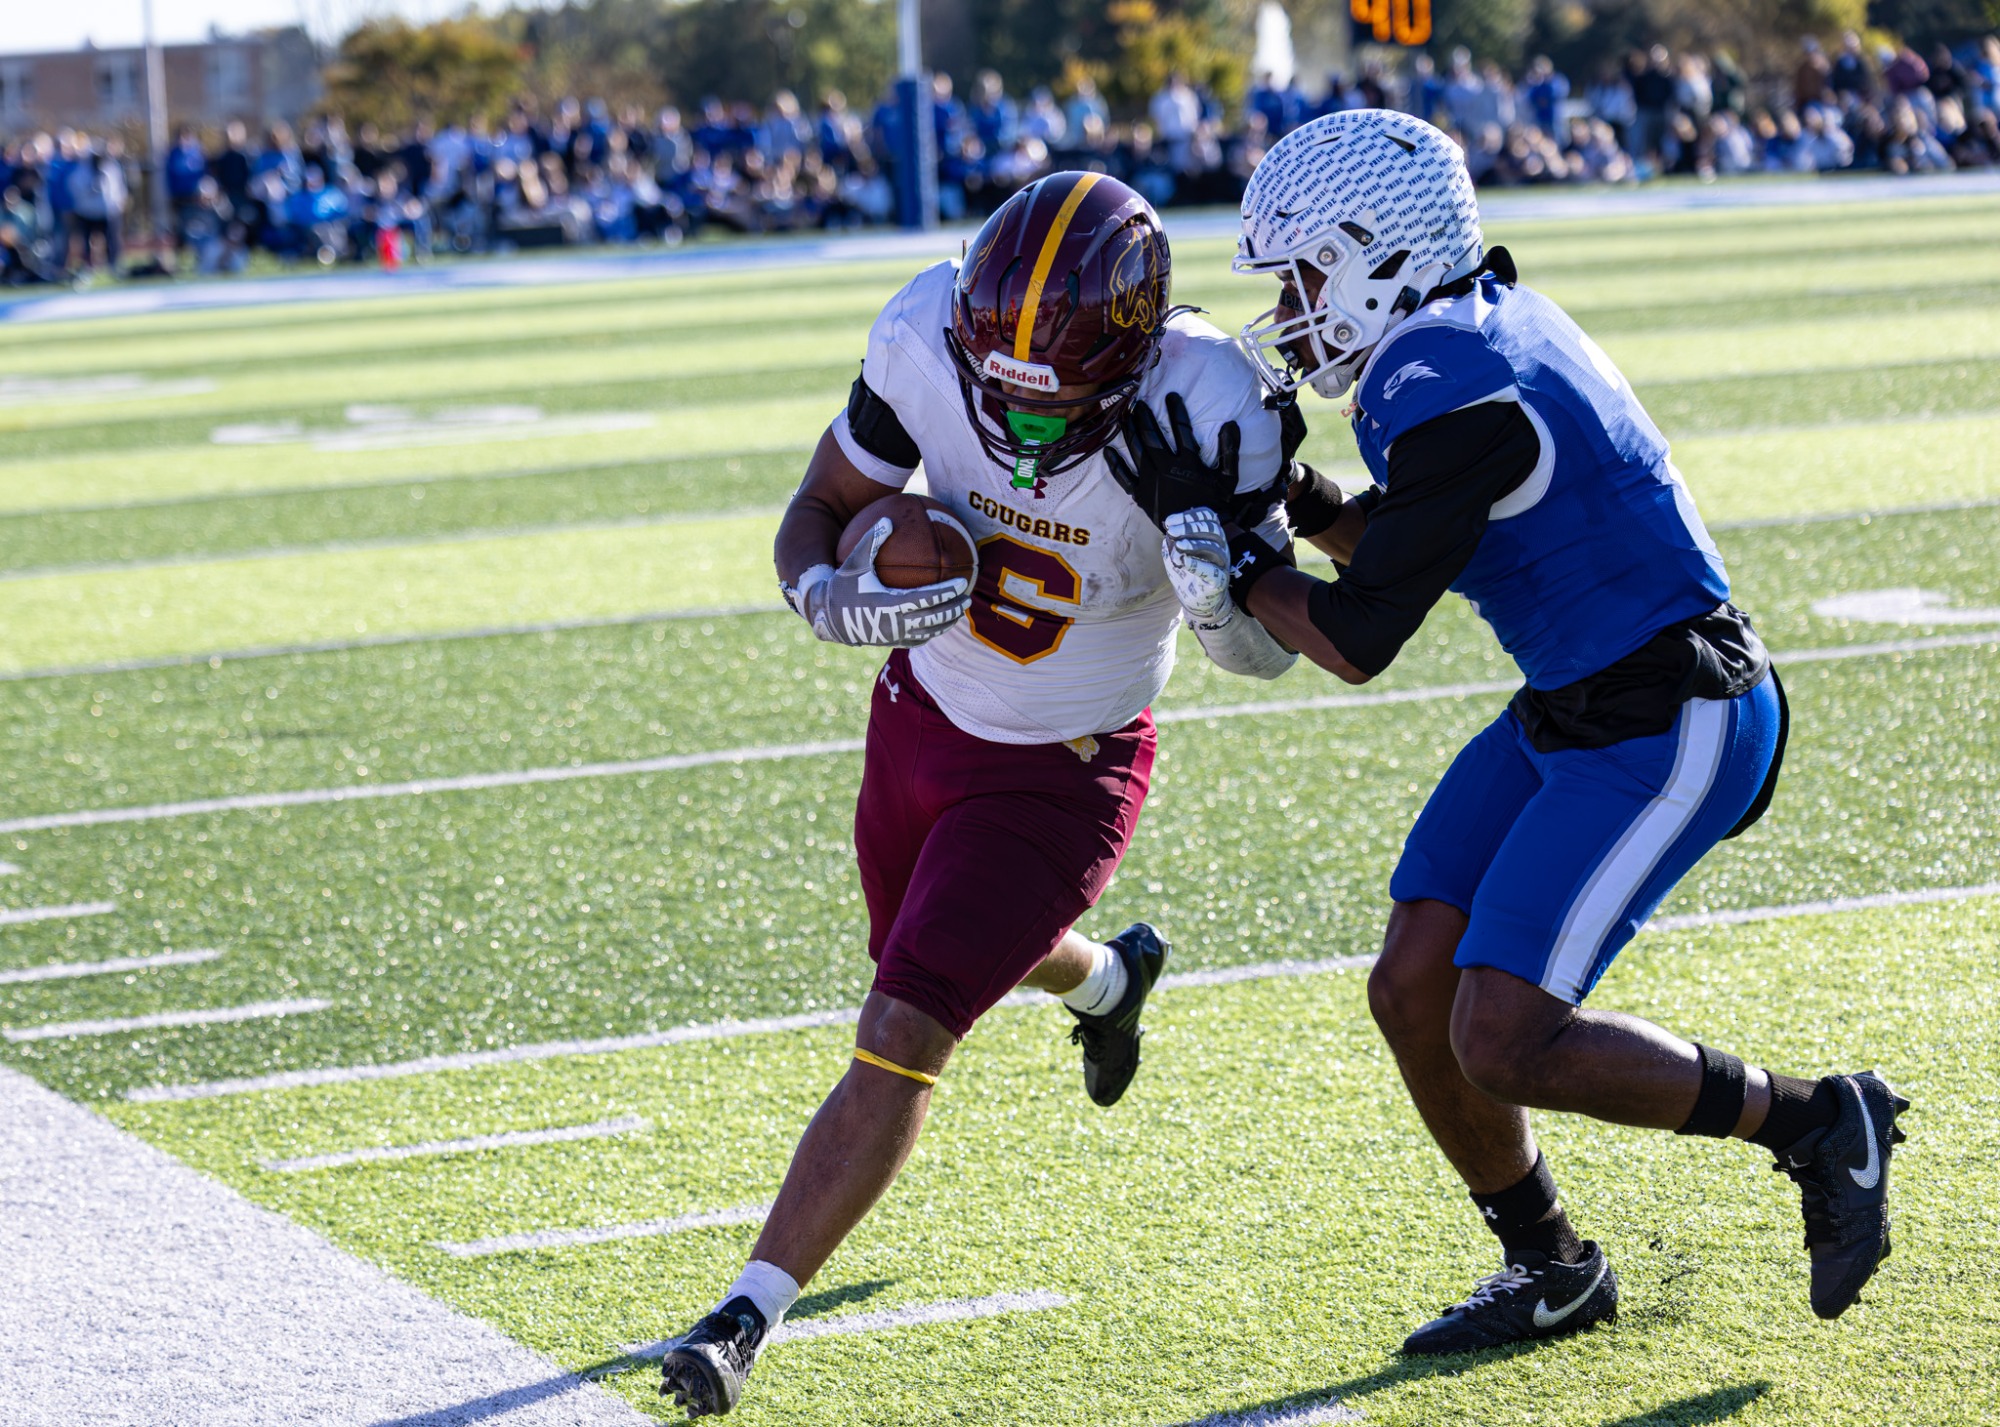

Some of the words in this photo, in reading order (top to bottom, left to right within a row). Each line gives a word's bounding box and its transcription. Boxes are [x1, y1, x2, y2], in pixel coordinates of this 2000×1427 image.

[1324, 126, 1345, 135] PRIDE
[1351, 121, 1368, 134] PRIDE
[1296, 134, 1315, 148] PRIDE
[1348, 135, 1366, 148] PRIDE
[1380, 140, 1393, 151] PRID
[1273, 149, 1291, 164] PRIDE
[1295, 145, 1313, 161] PRIDE
[1326, 142, 1344, 157] PRIDE
[1338, 149, 1357, 164] PRIDE
[1359, 142, 1377, 156] PRIDE
[1390, 149, 1407, 162] PRIDE
[1307, 149, 1325, 166] PRIDE
[1369, 153, 1387, 168] PRIDE
[1420, 157, 1436, 169] PRIDE
[1276, 159, 1291, 177] PRIDE
[1288, 160, 1304, 177] PRIDE
[1316, 158, 1334, 175] PRIDE
[1347, 159, 1366, 174] PRIDE
[1377, 164, 1395, 179] PRIDE
[1399, 160, 1417, 173] PRIDE
[1295, 169, 1312, 186] PRIDE
[1325, 167, 1344, 184] PRIDE
[1355, 170, 1374, 186] PRIDE
[1408, 172, 1425, 186] PRIDE
[1428, 171, 1444, 184] PRIDE
[1269, 176, 1284, 194] PRIDE
[1276, 181, 1291, 200] PRIDE
[1304, 178, 1321, 195] PRIDE
[1333, 177, 1352, 195] PRIDE
[1362, 182, 1381, 198] PRIDE
[1385, 177, 1404, 192] PRIDE
[1285, 192, 1300, 210] PRIDE
[1312, 187, 1329, 205] PRIDE
[1341, 188, 1360, 205] PRIDE
[1392, 189, 1412, 204] PRIDE
[1414, 187, 1432, 201] PRIDE
[1262, 200, 1274, 219] PRIDE
[1317, 198, 1337, 215] PRIDE
[1348, 201, 1366, 219] PRIDE
[1398, 203, 1417, 219] PRIDE
[1420, 200, 1437, 215] PRIDE
[1297, 206, 1315, 224] PRIDE
[1327, 209, 1345, 225] PRIDE
[1376, 207, 1395, 223] PRIDE
[1424, 215, 1442, 229] PRIDE
[1305, 219, 1323, 236] PRIDE
[1380, 221, 1400, 237] PRIDE
[1404, 217, 1423, 231] PRIDE
[1265, 228, 1276, 248] PRIDE
[1285, 227, 1301, 245] PRIDE
[1386, 234, 1406, 249] PRIDE
[1409, 232, 1428, 246] PRIDE
[1362, 241, 1383, 256] PRIDE
[1412, 248, 1431, 261] PRIDE
[1433, 244, 1450, 258] PRIDE
[1450, 244, 1464, 258] PRIDE
[1368, 252, 1388, 267] PRIDE
[989, 359, 1049, 386] Riddell
[968, 490, 1091, 546] COUGARS
[964, 532, 1083, 665] 6
